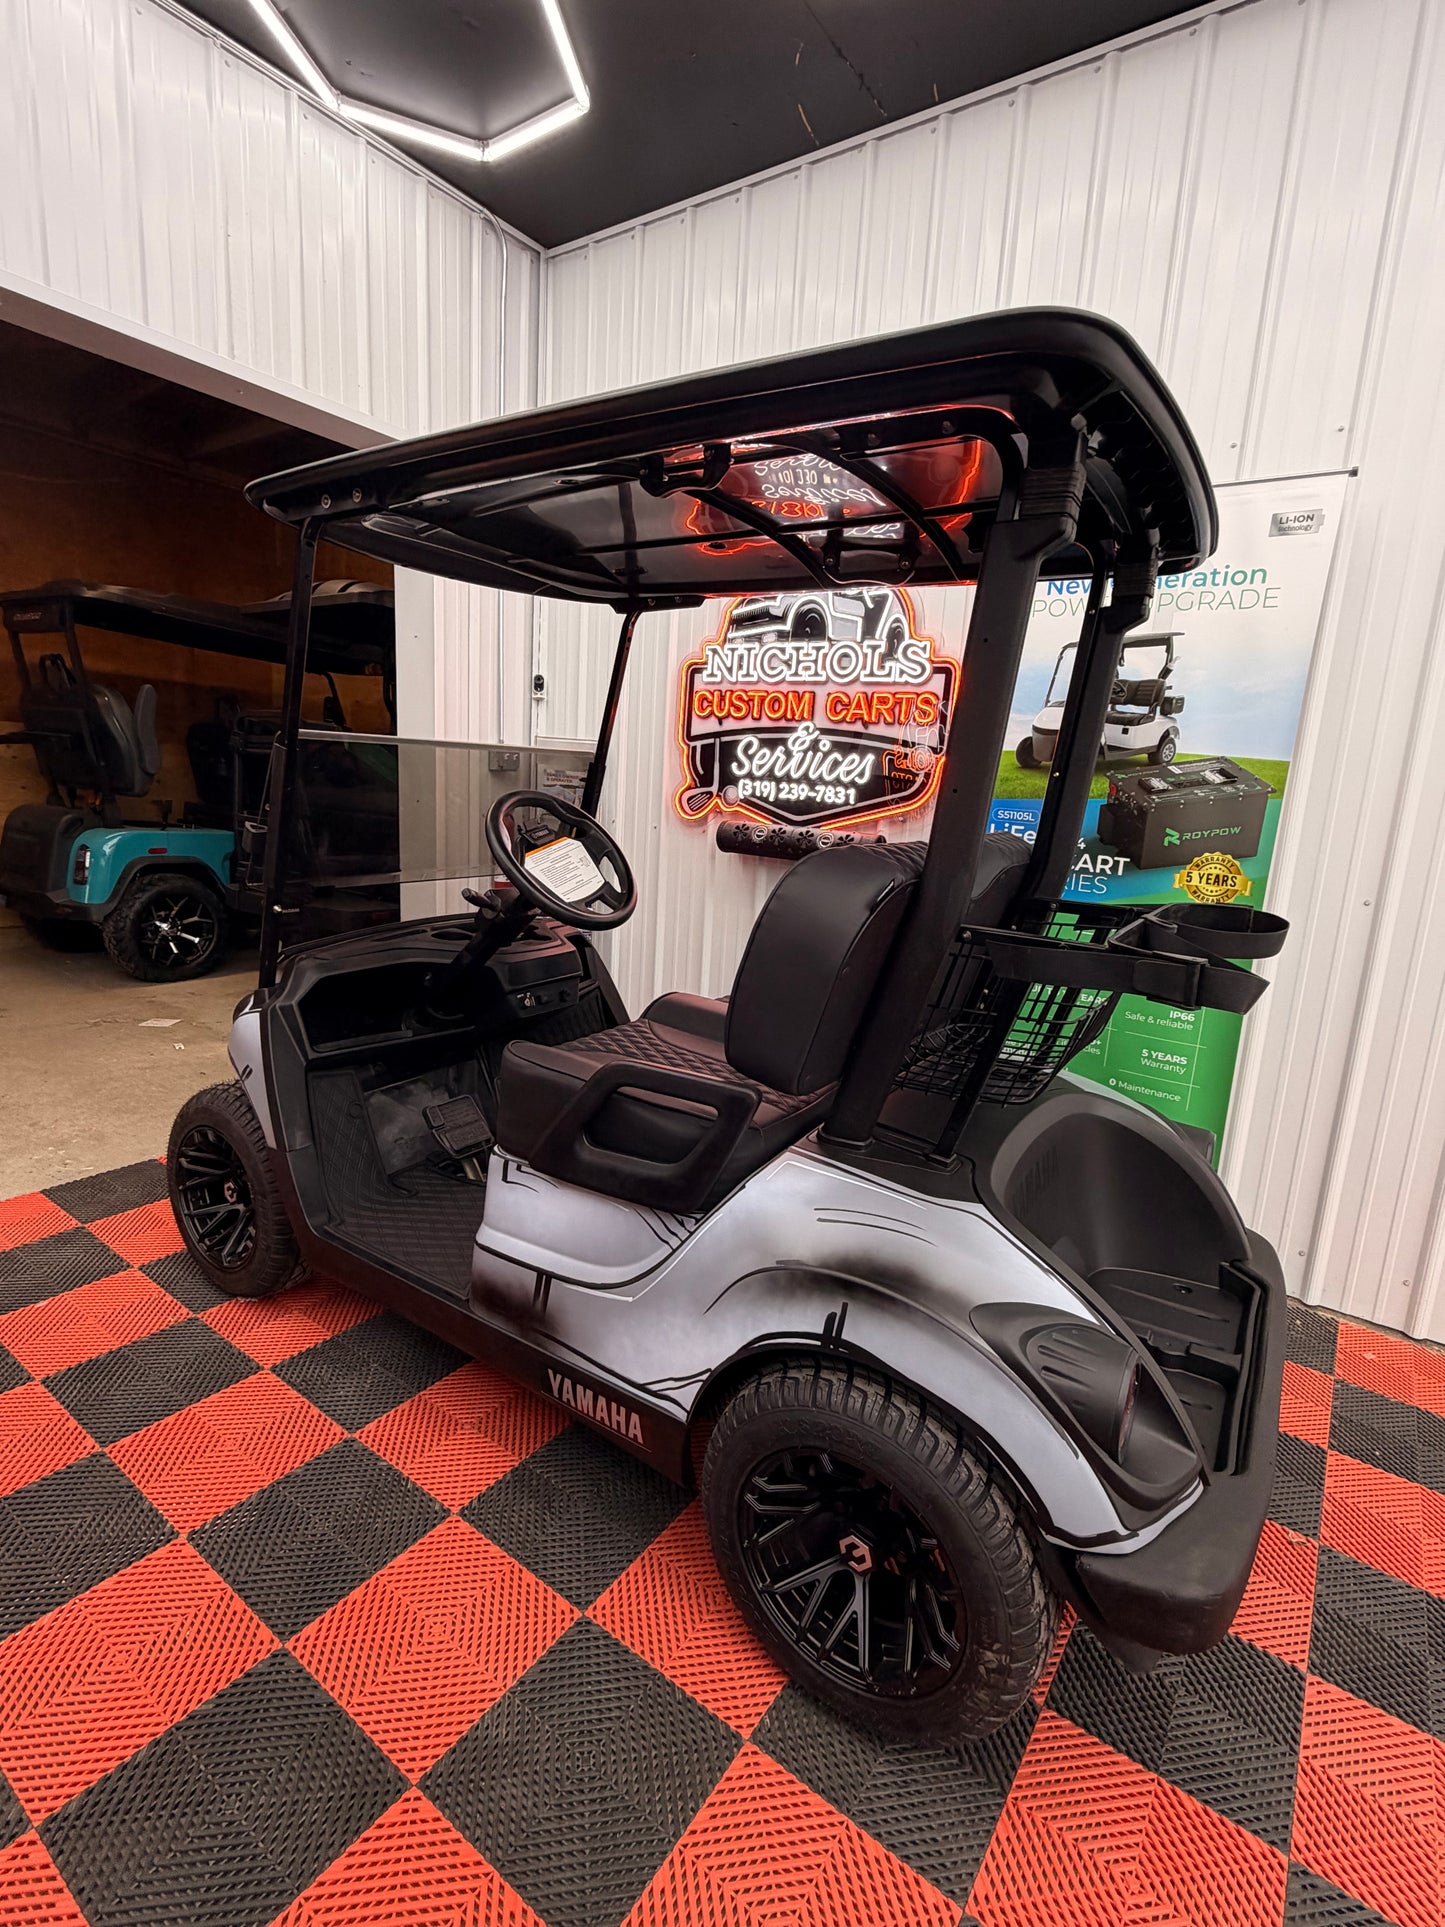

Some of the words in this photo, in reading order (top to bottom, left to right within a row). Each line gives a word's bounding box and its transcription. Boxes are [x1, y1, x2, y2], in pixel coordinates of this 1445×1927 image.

[1279, 513, 1315, 525] LI-ION
[1157, 587, 1281, 613] PGRADE
[702, 640, 932, 684] NICHOLS
[693, 689, 815, 721] CUSTOM
[825, 691, 939, 724] CARTS
[787, 720, 820, 751] &
[731, 735, 875, 784] Services
[737, 778, 776, 802] (319)
[778, 782, 857, 805] 239-7831
[1182, 826, 1242, 840] ROYPOW
[1070, 853, 1131, 876] ART
[1194, 856, 1235, 868] WARRANTY
[1186, 871, 1194, 883] 5
[1198, 872, 1238, 888] YEARS
[1124, 1010, 1146, 1022] Safe
[1147, 1015, 1155, 1024] &
[1156, 1017, 1194, 1031] reliable
[1169, 1010, 1195, 1022] IP66
[1140, 1057, 1187, 1075] Warranty
[1141, 1049, 1149, 1057] 5
[1151, 1050, 1188, 1065] YEARS
[1118, 1080, 1182, 1102] Maintenance
[547, 1367, 644, 1445] YAMAHA
